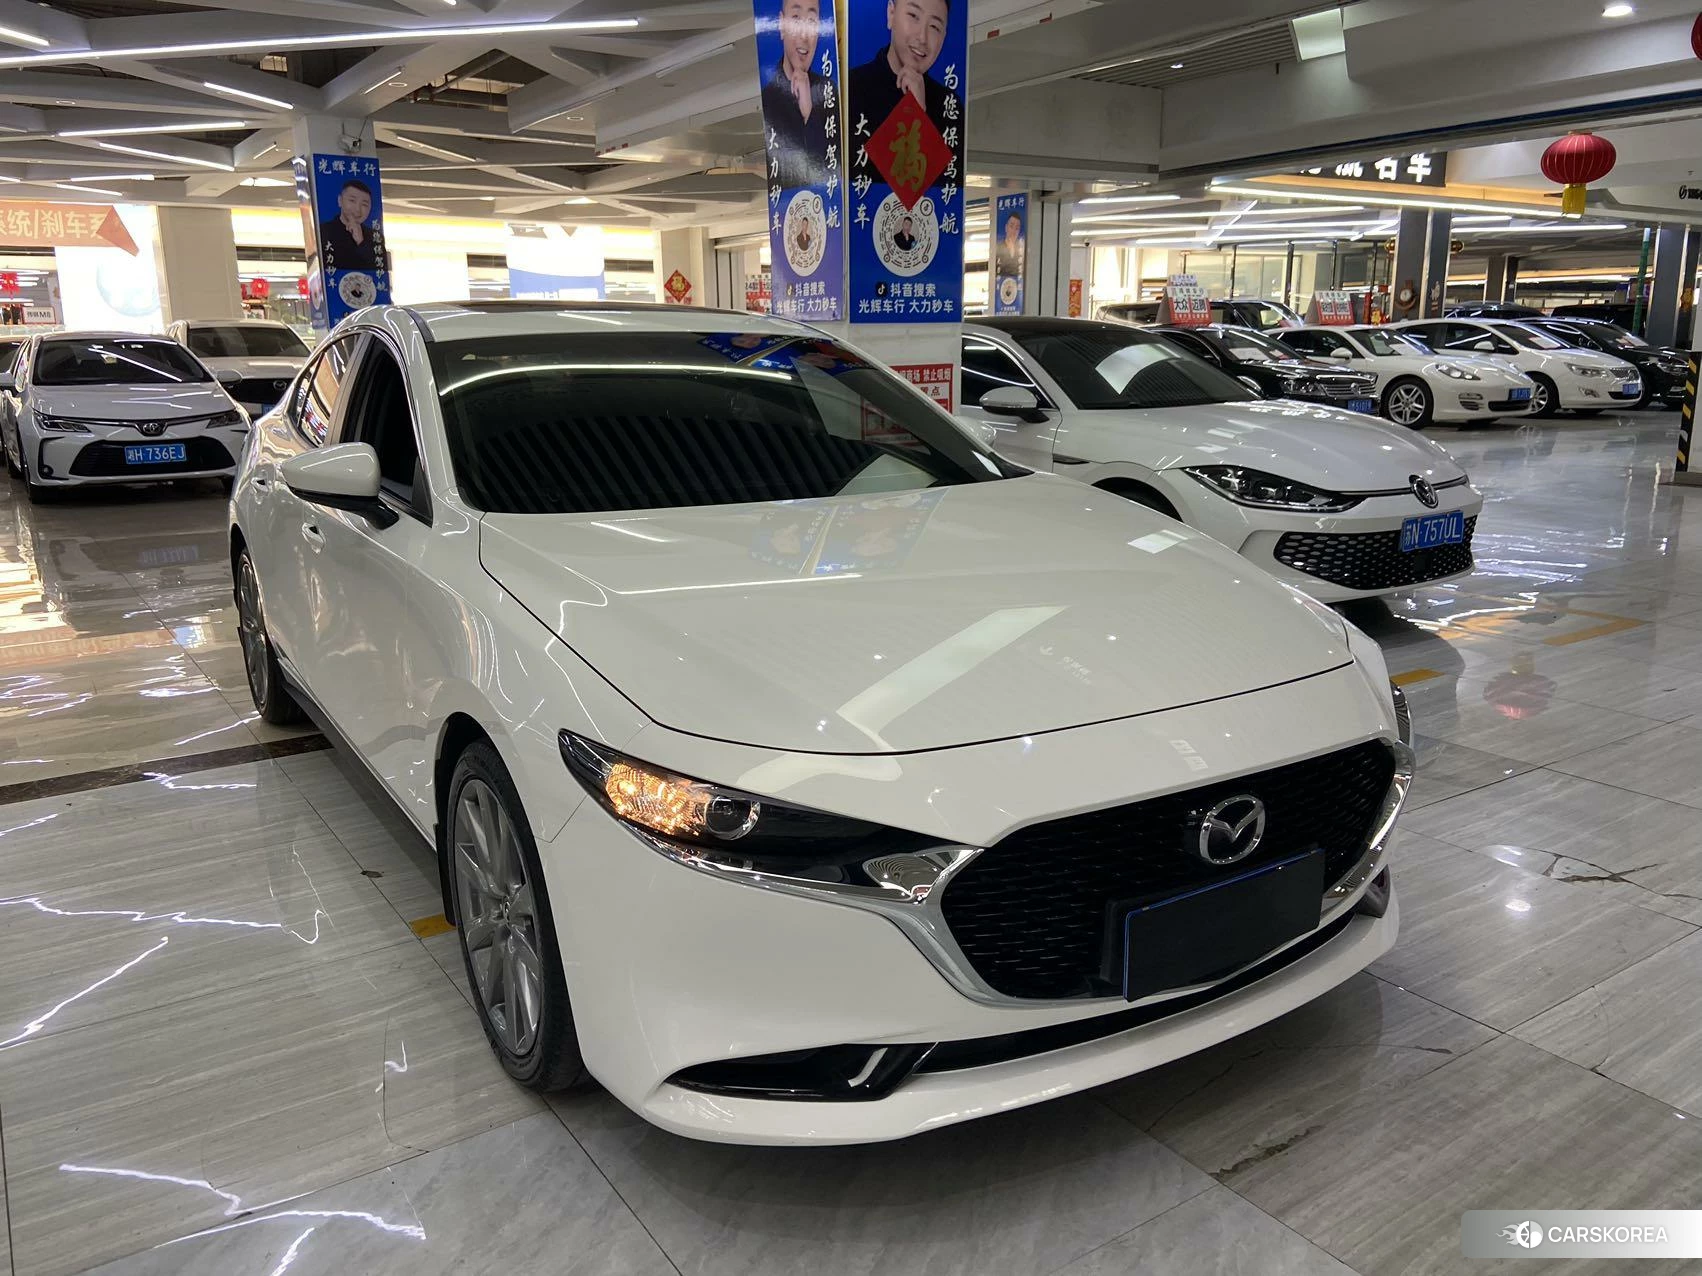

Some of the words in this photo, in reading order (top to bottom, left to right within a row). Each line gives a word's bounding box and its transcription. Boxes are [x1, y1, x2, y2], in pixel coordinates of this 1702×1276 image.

[821, 49, 841, 229] 为您保驾护航
[889, 119, 928, 192] 福
[318, 158, 377, 177] 光辉车行
[852, 113, 873, 230] 大力秒车
[1300, 153, 1432, 183] 名车
[768, 128, 783, 236] 大力秒车
[795, 281, 825, 297] 抖音搜索
[890, 283, 936, 298] 抖音搜索
[776, 299, 805, 314] 光辉车行
[806, 297, 837, 312] 大力秒车
[858, 299, 905, 314] 光辉车行
[908, 299, 954, 314] 大力秒车
[923, 368, 952, 382] 禁止吸烟
